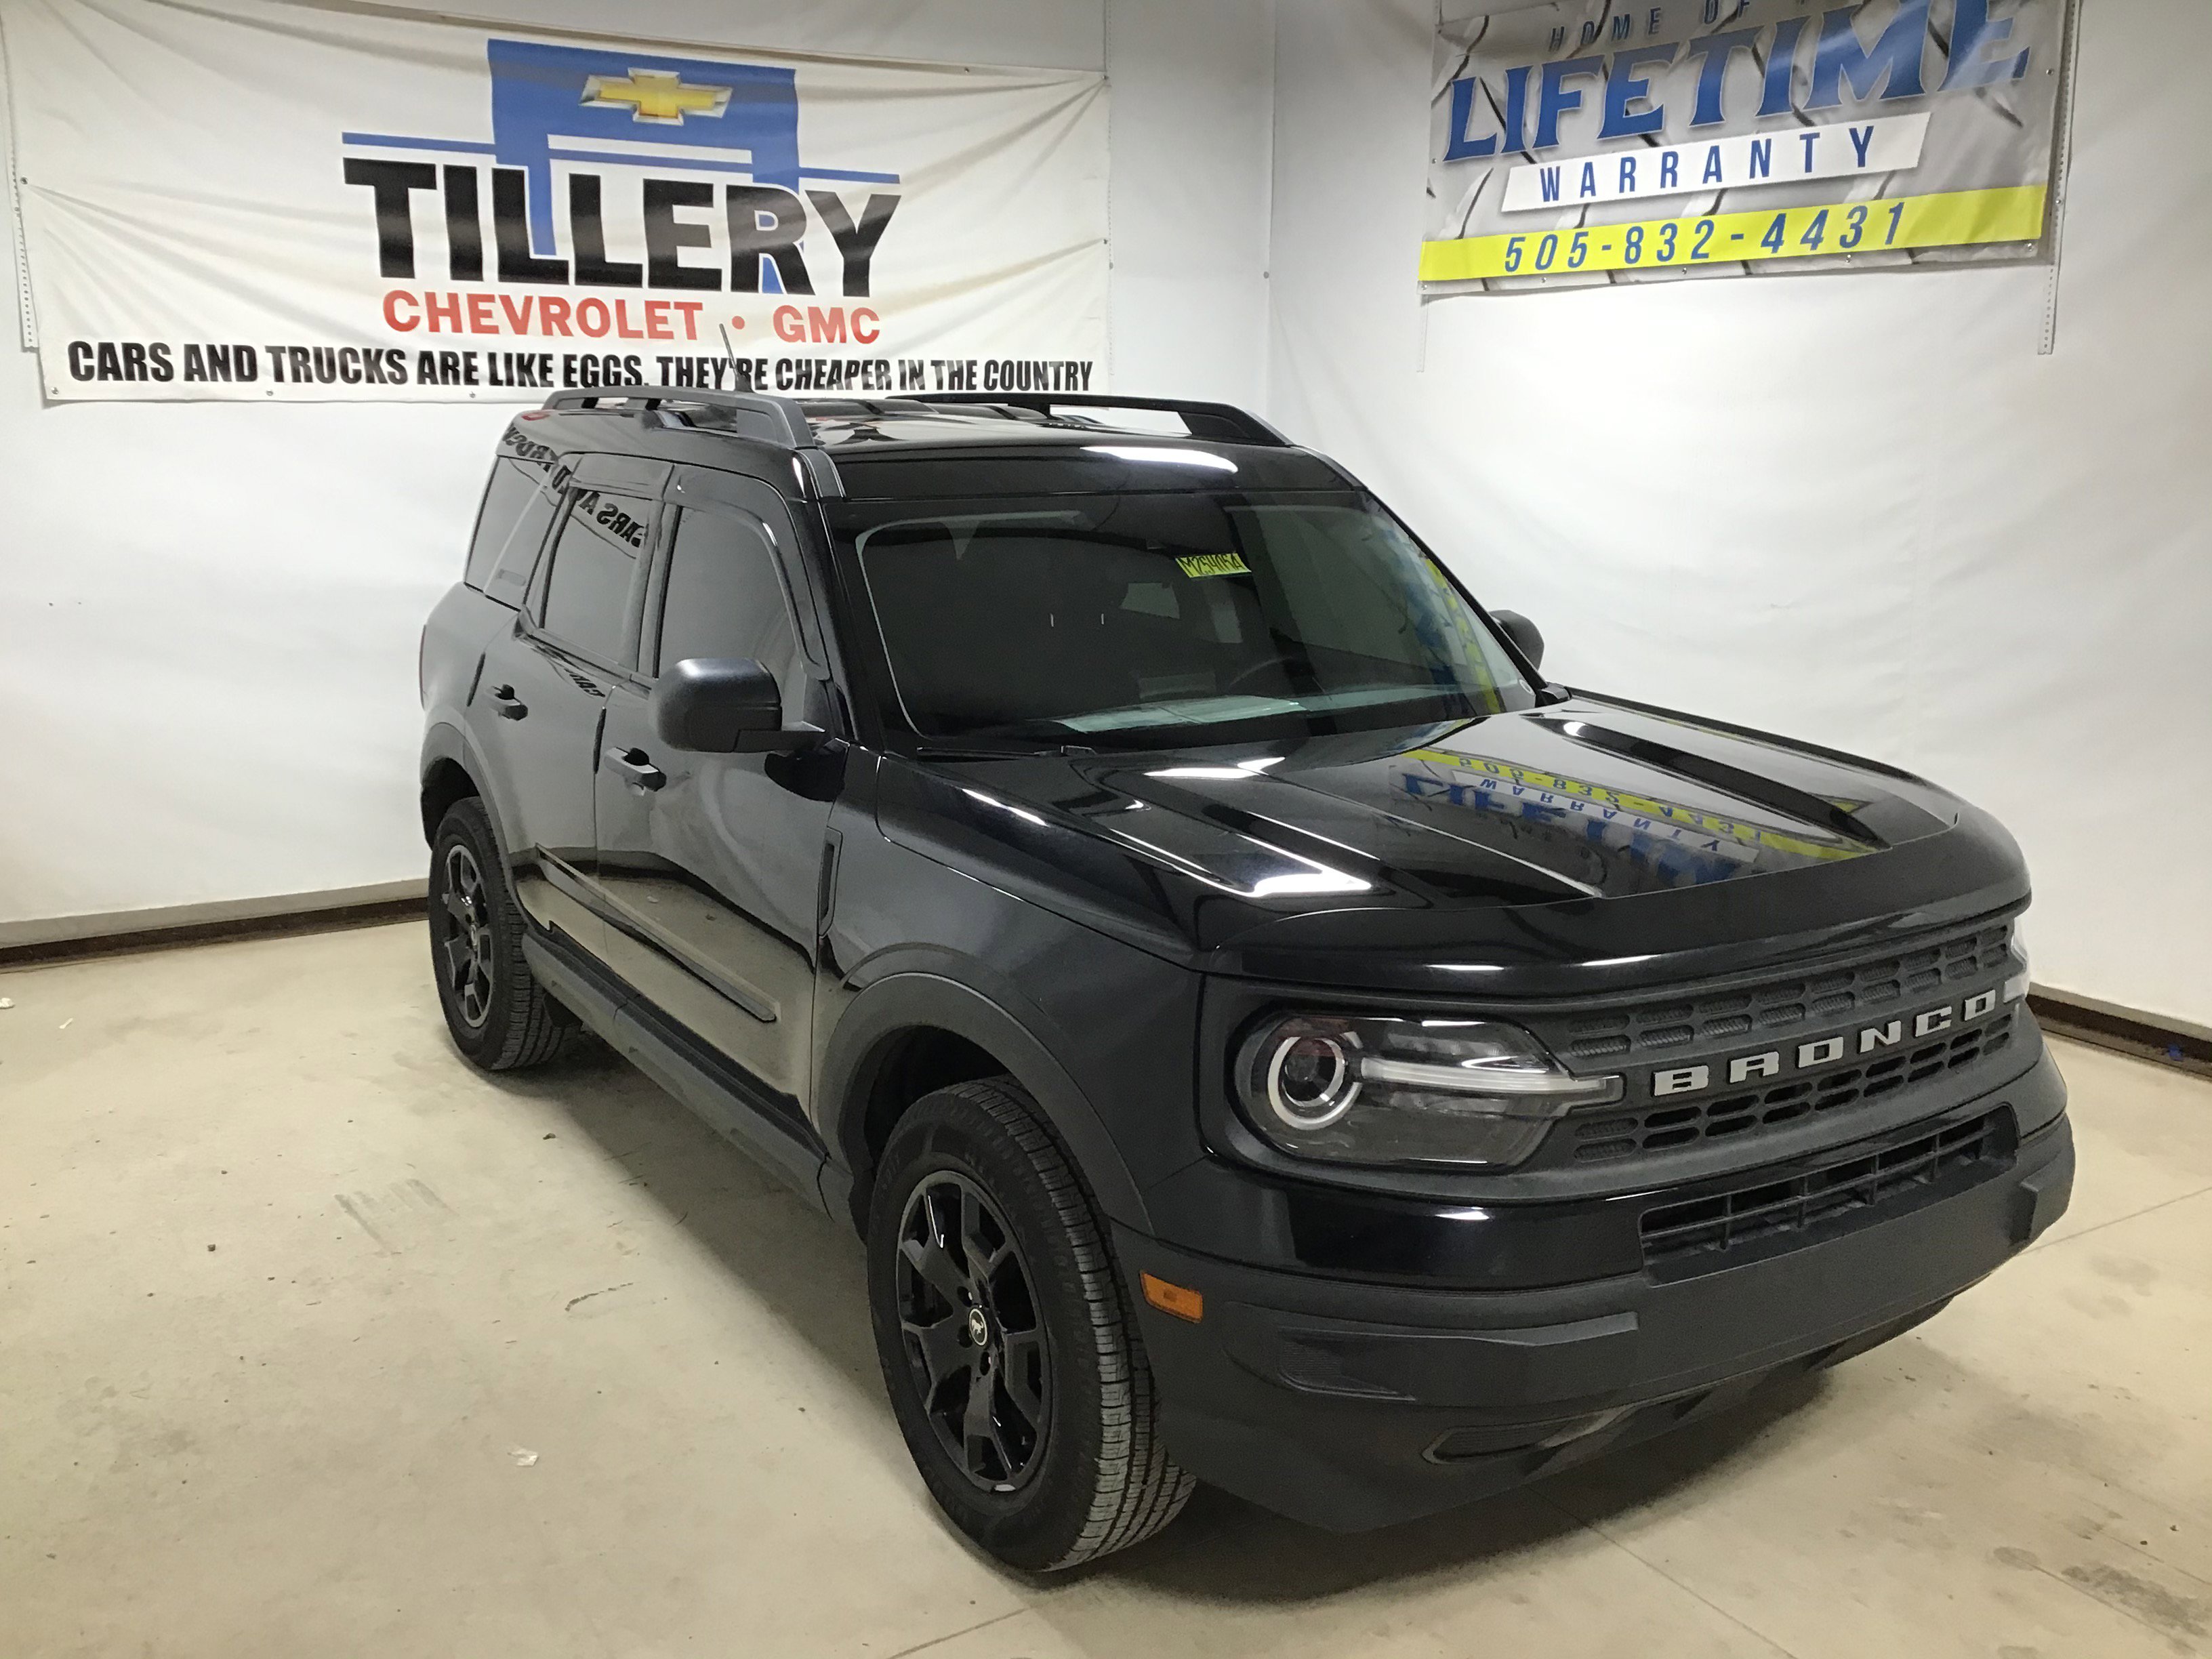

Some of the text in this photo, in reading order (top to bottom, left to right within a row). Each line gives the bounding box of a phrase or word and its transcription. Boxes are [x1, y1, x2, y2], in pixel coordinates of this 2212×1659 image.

[1549, 0, 1750, 52] HOME OF
[1442, 0, 2030, 163] LIFETIME
[1540, 125, 1875, 203] WARRANTY
[343, 157, 901, 298] TILLERY
[1504, 201, 1906, 273] 505-832-4431
[383, 290, 880, 344] CHEVROLET GMC
[68, 341, 174, 383] CARS
[183, 344, 258, 383] AND
[266, 346, 407, 385] TRUCKS
[417, 351, 480, 386] ARE
[488, 352, 554, 388] LIKE
[656, 356, 769, 390] THEY'RE
[775, 357, 892, 391] CHEAPER
[899, 359, 926, 391] IN
[930, 359, 978, 392] THE
[984, 361, 1093, 392] COUNTRY
[1652, 989, 1995, 1097] BRONCO
